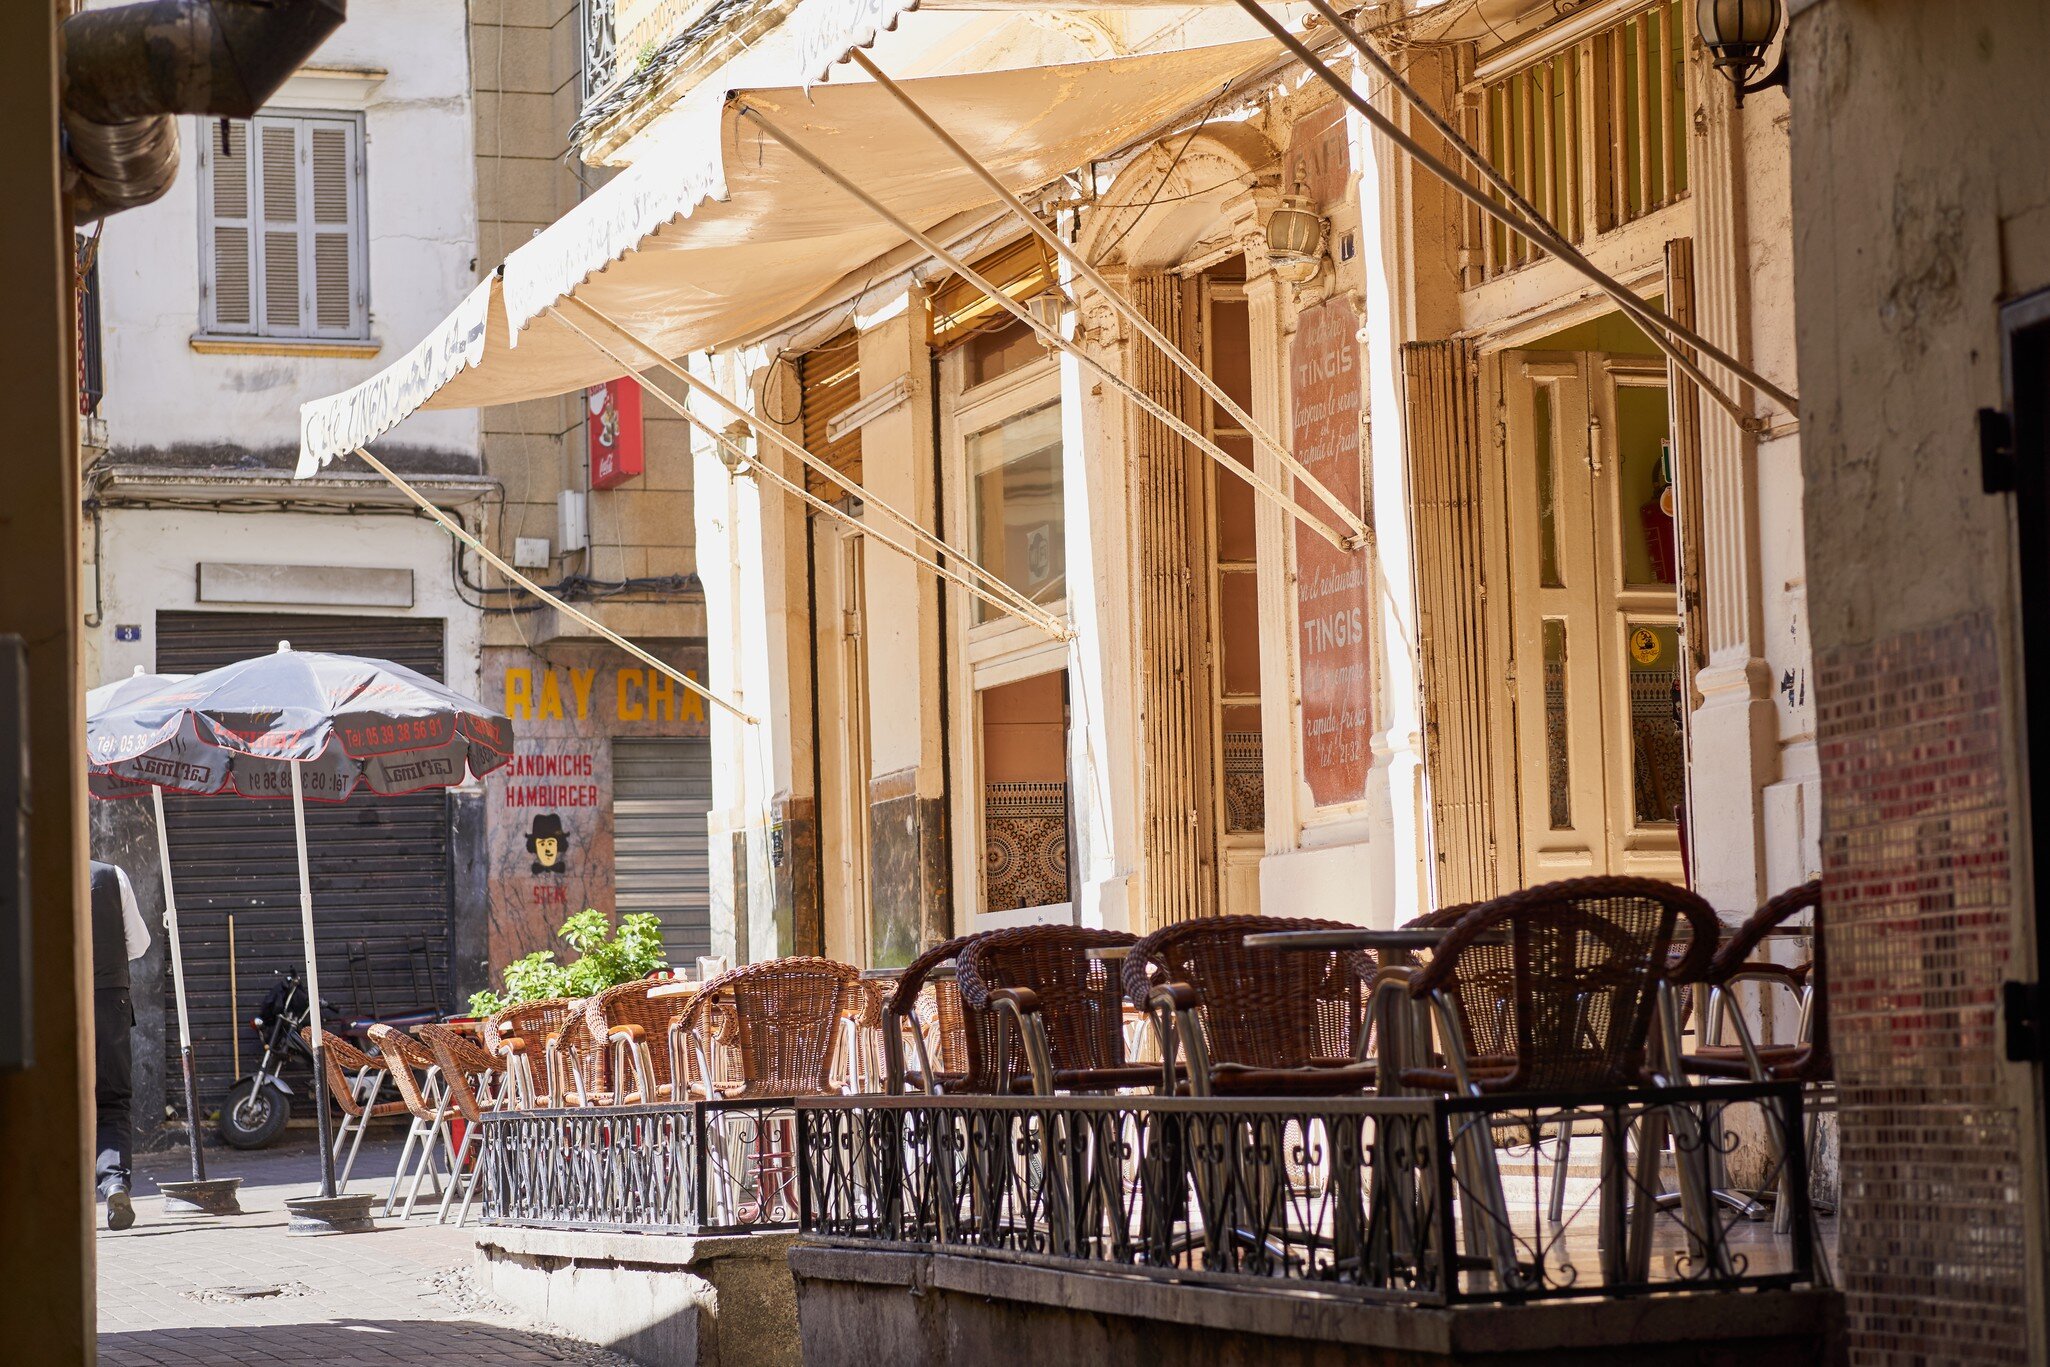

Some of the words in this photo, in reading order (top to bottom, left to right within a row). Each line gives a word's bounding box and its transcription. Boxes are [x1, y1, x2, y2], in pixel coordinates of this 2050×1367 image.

[1299, 345, 1353, 388] TINGIS
[124, 627, 133, 640] 3
[1304, 606, 1363, 655] TINGIS
[503, 668, 596, 722] RAY
[120, 734, 134, 753] 05
[134, 733, 148, 751] 39
[345, 727, 365, 749] Tél:
[366, 728, 379, 746] 05
[380, 724, 394, 744] 39
[396, 722, 410, 743] 38
[413, 720, 427, 741] 56
[429, 718, 443, 737] 91
[506, 754, 593, 777] SANDWICHS
[506, 785, 598, 808] HAMBURGER
[533, 885, 569, 905] STEAK
